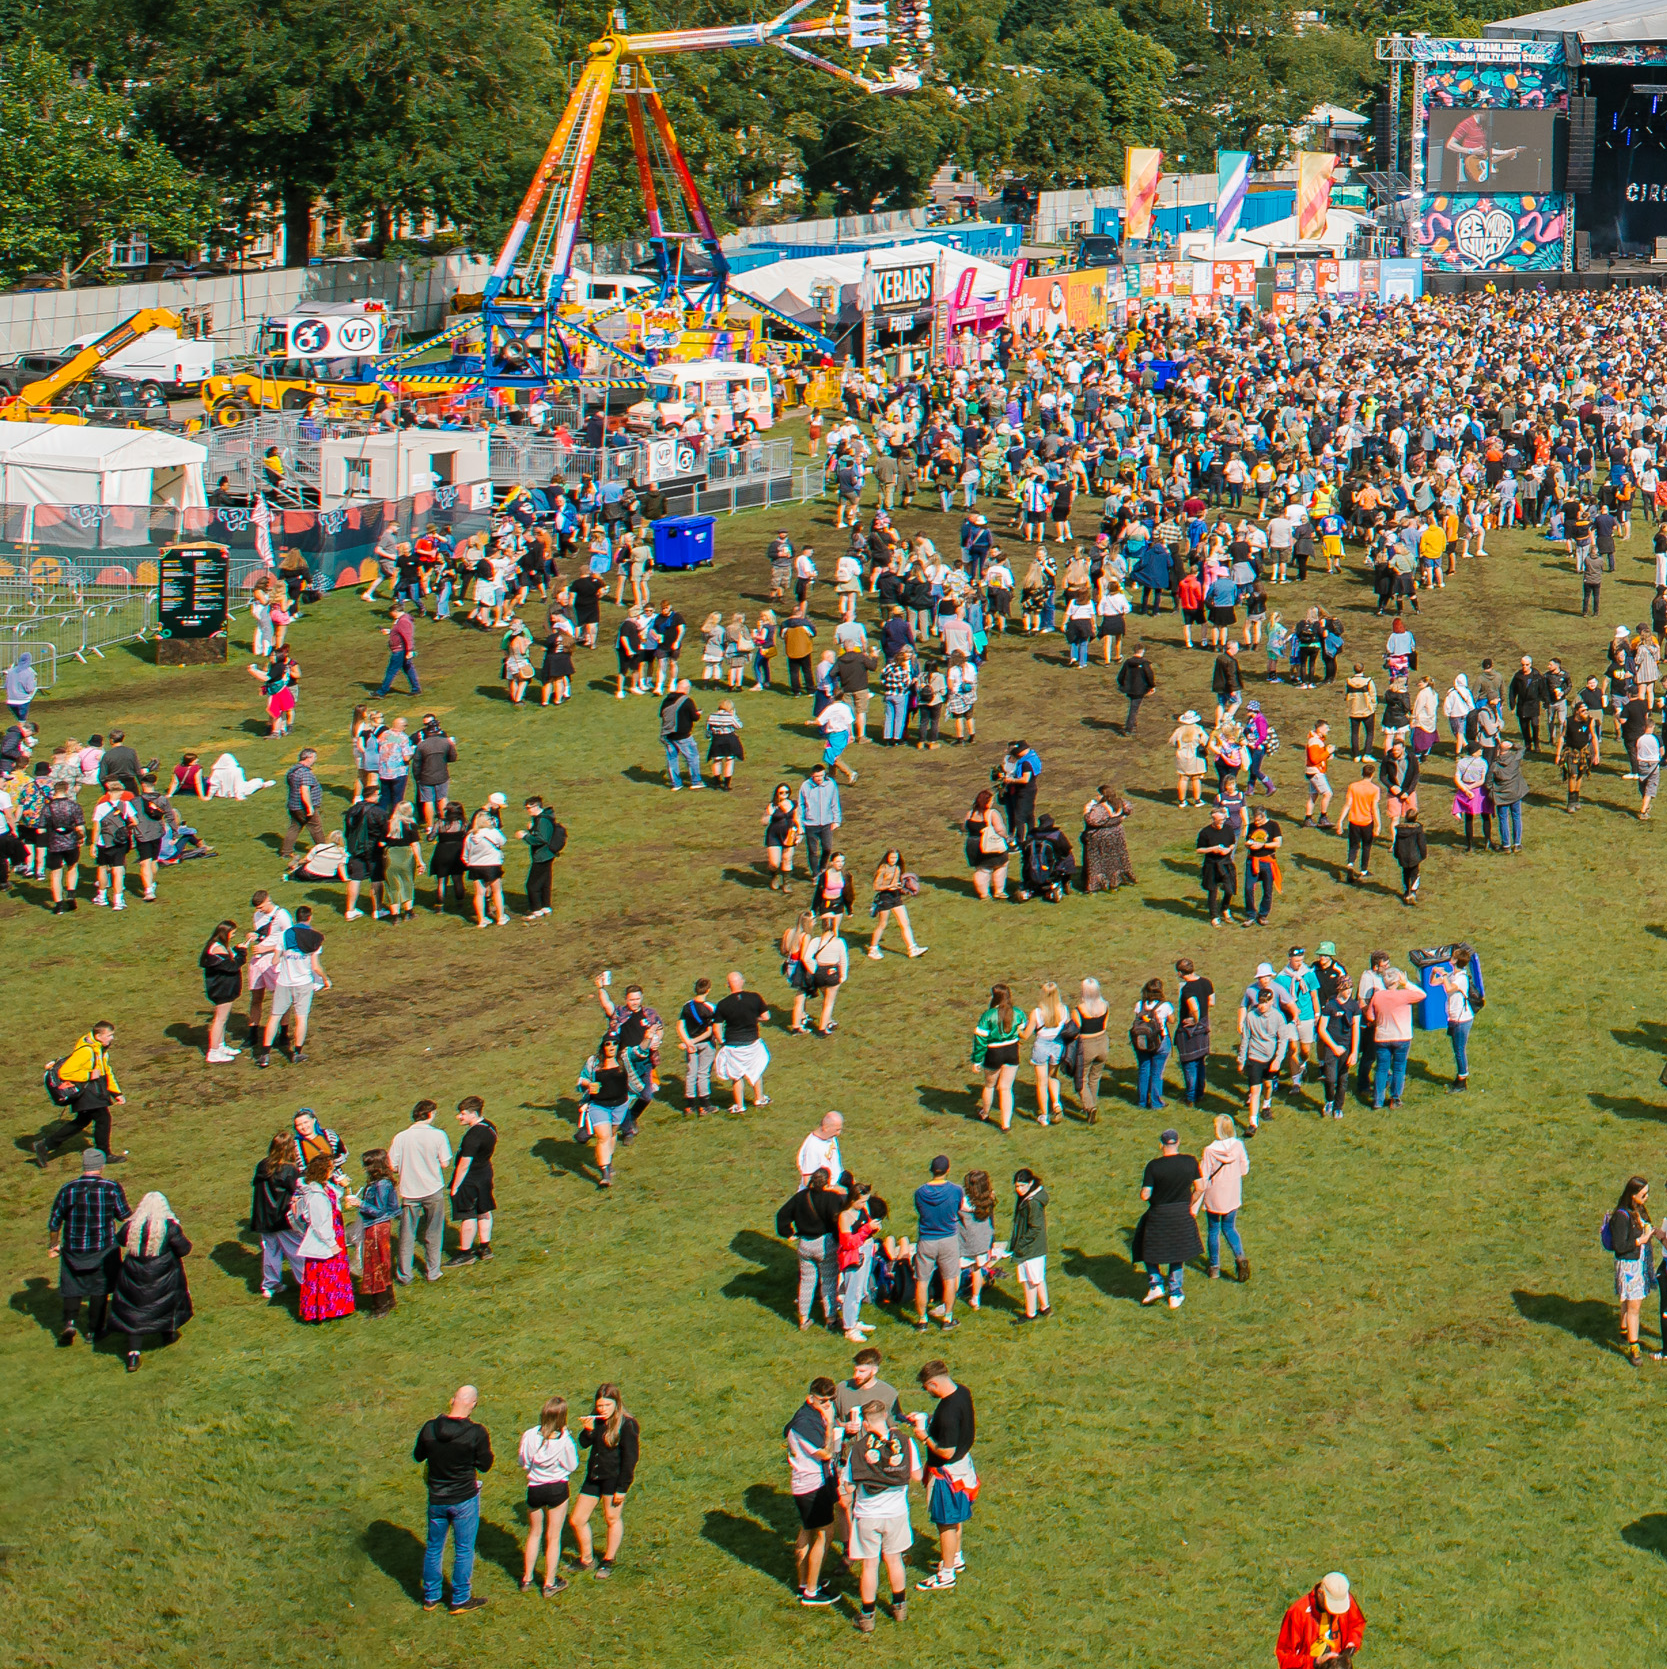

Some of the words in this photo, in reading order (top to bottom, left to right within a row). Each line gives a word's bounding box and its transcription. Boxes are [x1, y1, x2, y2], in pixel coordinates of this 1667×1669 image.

[1474, 43, 1522, 53] TRAMLINES
[1432, 52, 1449, 61] THE
[1450, 52, 1475, 61] SARAH
[1501, 53, 1521, 62] MAIN
[1460, 214, 1484, 238] BE
[1486, 214, 1511, 238] MORE
[1461, 237, 1508, 258] NULTY
[874, 266, 931, 305] KEBABS
[889, 315, 914, 332] FRIES
[343, 328, 371, 342] VP
[658, 449, 670, 460] VP
